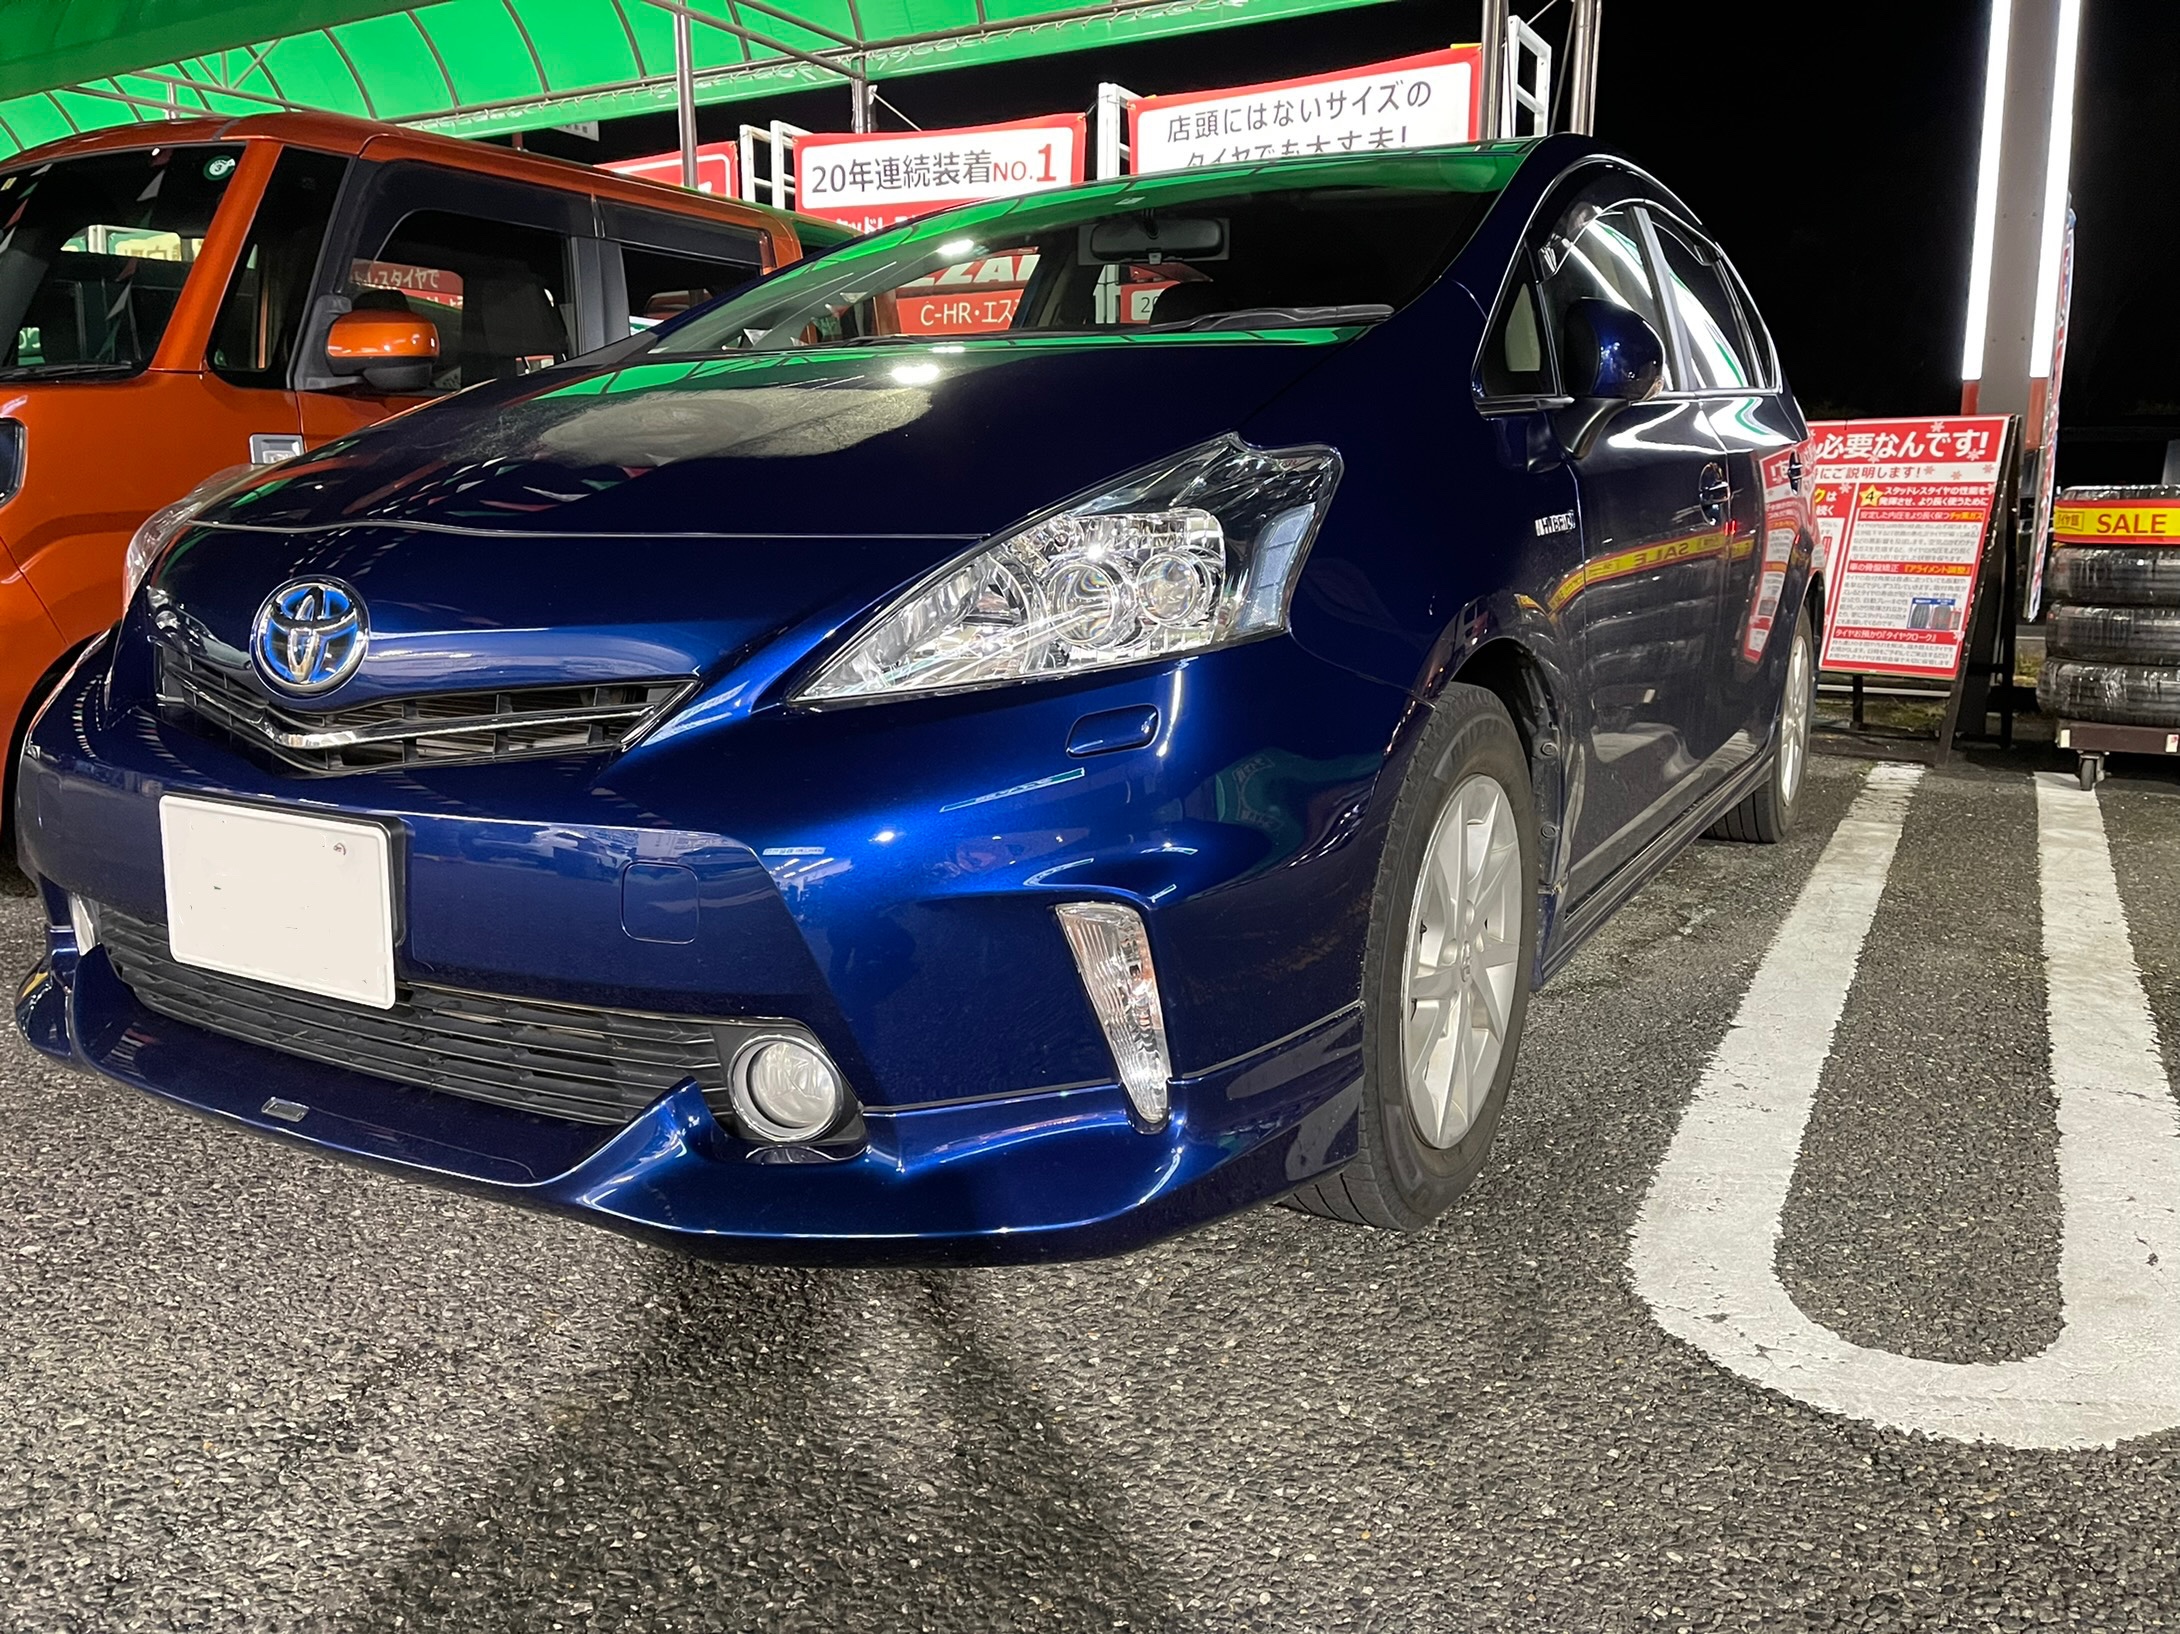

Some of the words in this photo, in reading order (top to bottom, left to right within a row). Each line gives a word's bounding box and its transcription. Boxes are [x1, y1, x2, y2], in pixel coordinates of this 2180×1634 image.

[1167, 79, 1432, 144] 店頭にはないサイズの
[1817, 430, 1990, 460] 必要なんです!
[1815, 466, 1921, 481] にご説明します!
[1865, 490, 1875, 502] 4
[2097, 513, 2167, 534] SALE
